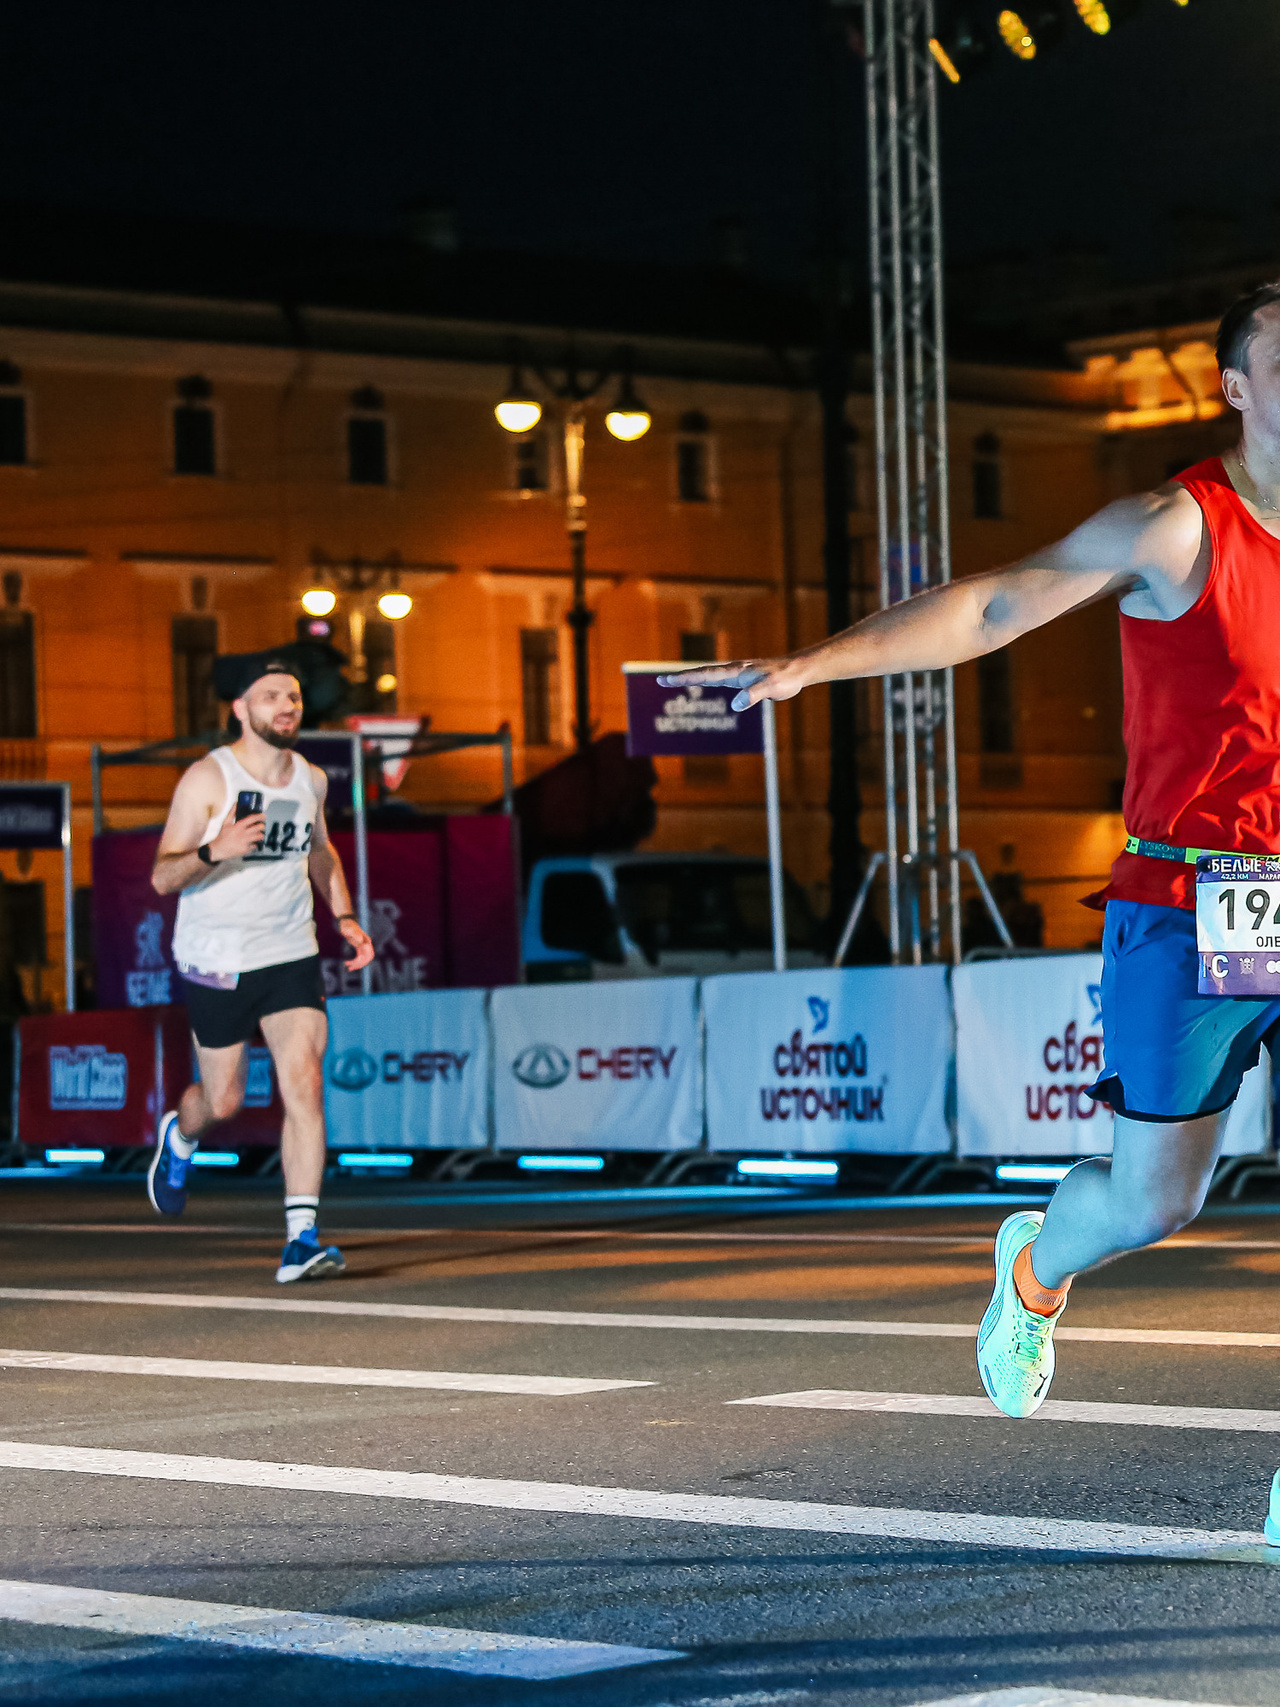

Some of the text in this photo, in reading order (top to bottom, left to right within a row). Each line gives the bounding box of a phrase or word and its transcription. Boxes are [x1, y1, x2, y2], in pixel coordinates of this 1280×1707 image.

[1211, 858, 1262, 873] БЕЛЫЕ
[383, 1051, 470, 1083] CHERY
[577, 1046, 678, 1080] CHERY
